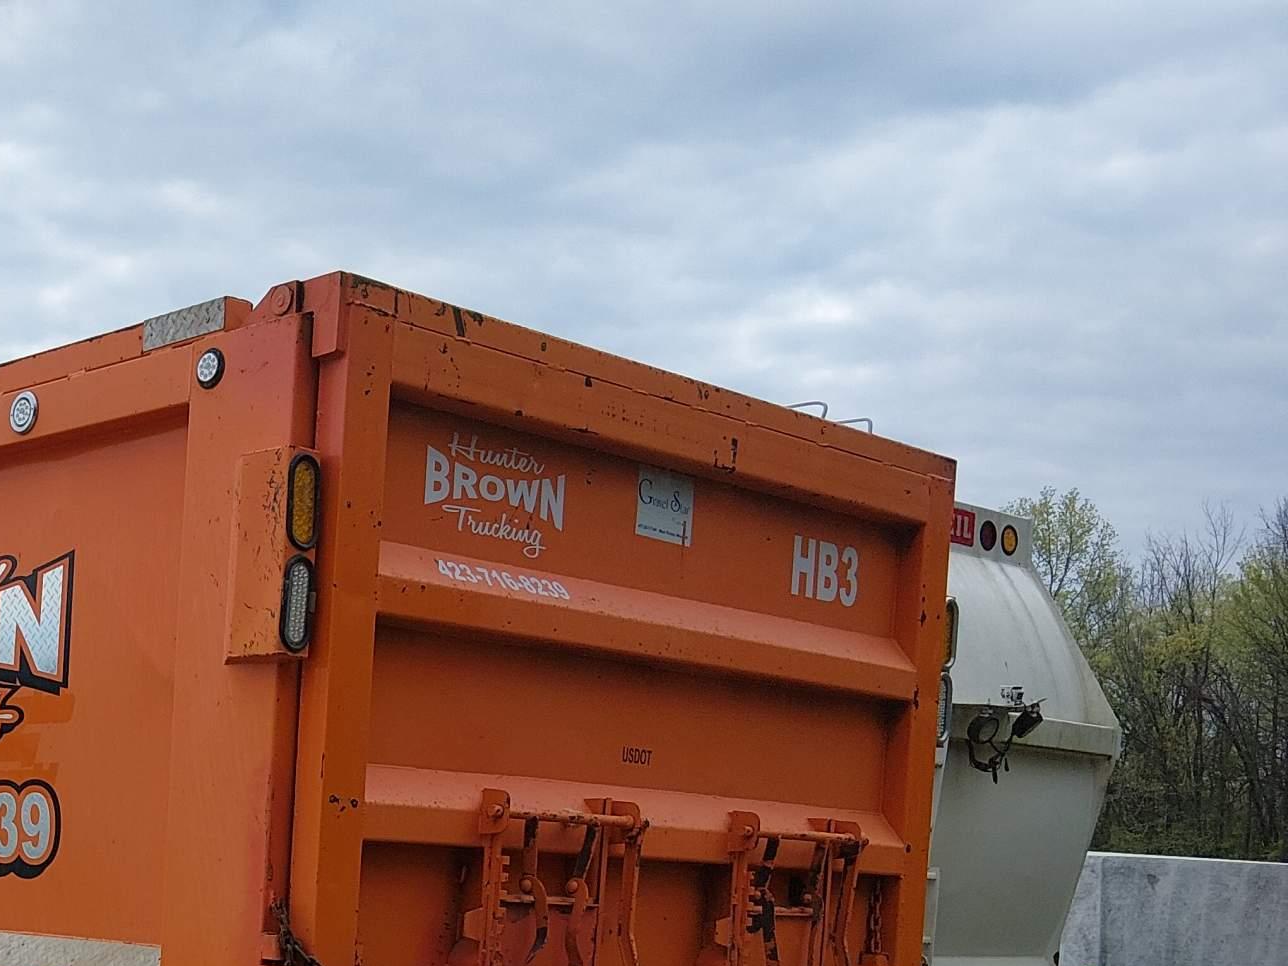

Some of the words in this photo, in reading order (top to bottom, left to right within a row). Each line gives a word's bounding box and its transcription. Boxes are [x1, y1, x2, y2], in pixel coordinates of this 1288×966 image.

[448, 432, 545, 474] Hunter
[424, 445, 566, 532] BROWN
[441, 504, 546, 559] Trucking
[435, 559, 570, 600] 423-716-8239
[791, 535, 858, 607] HB3
[622, 746, 653, 766] USDOT
